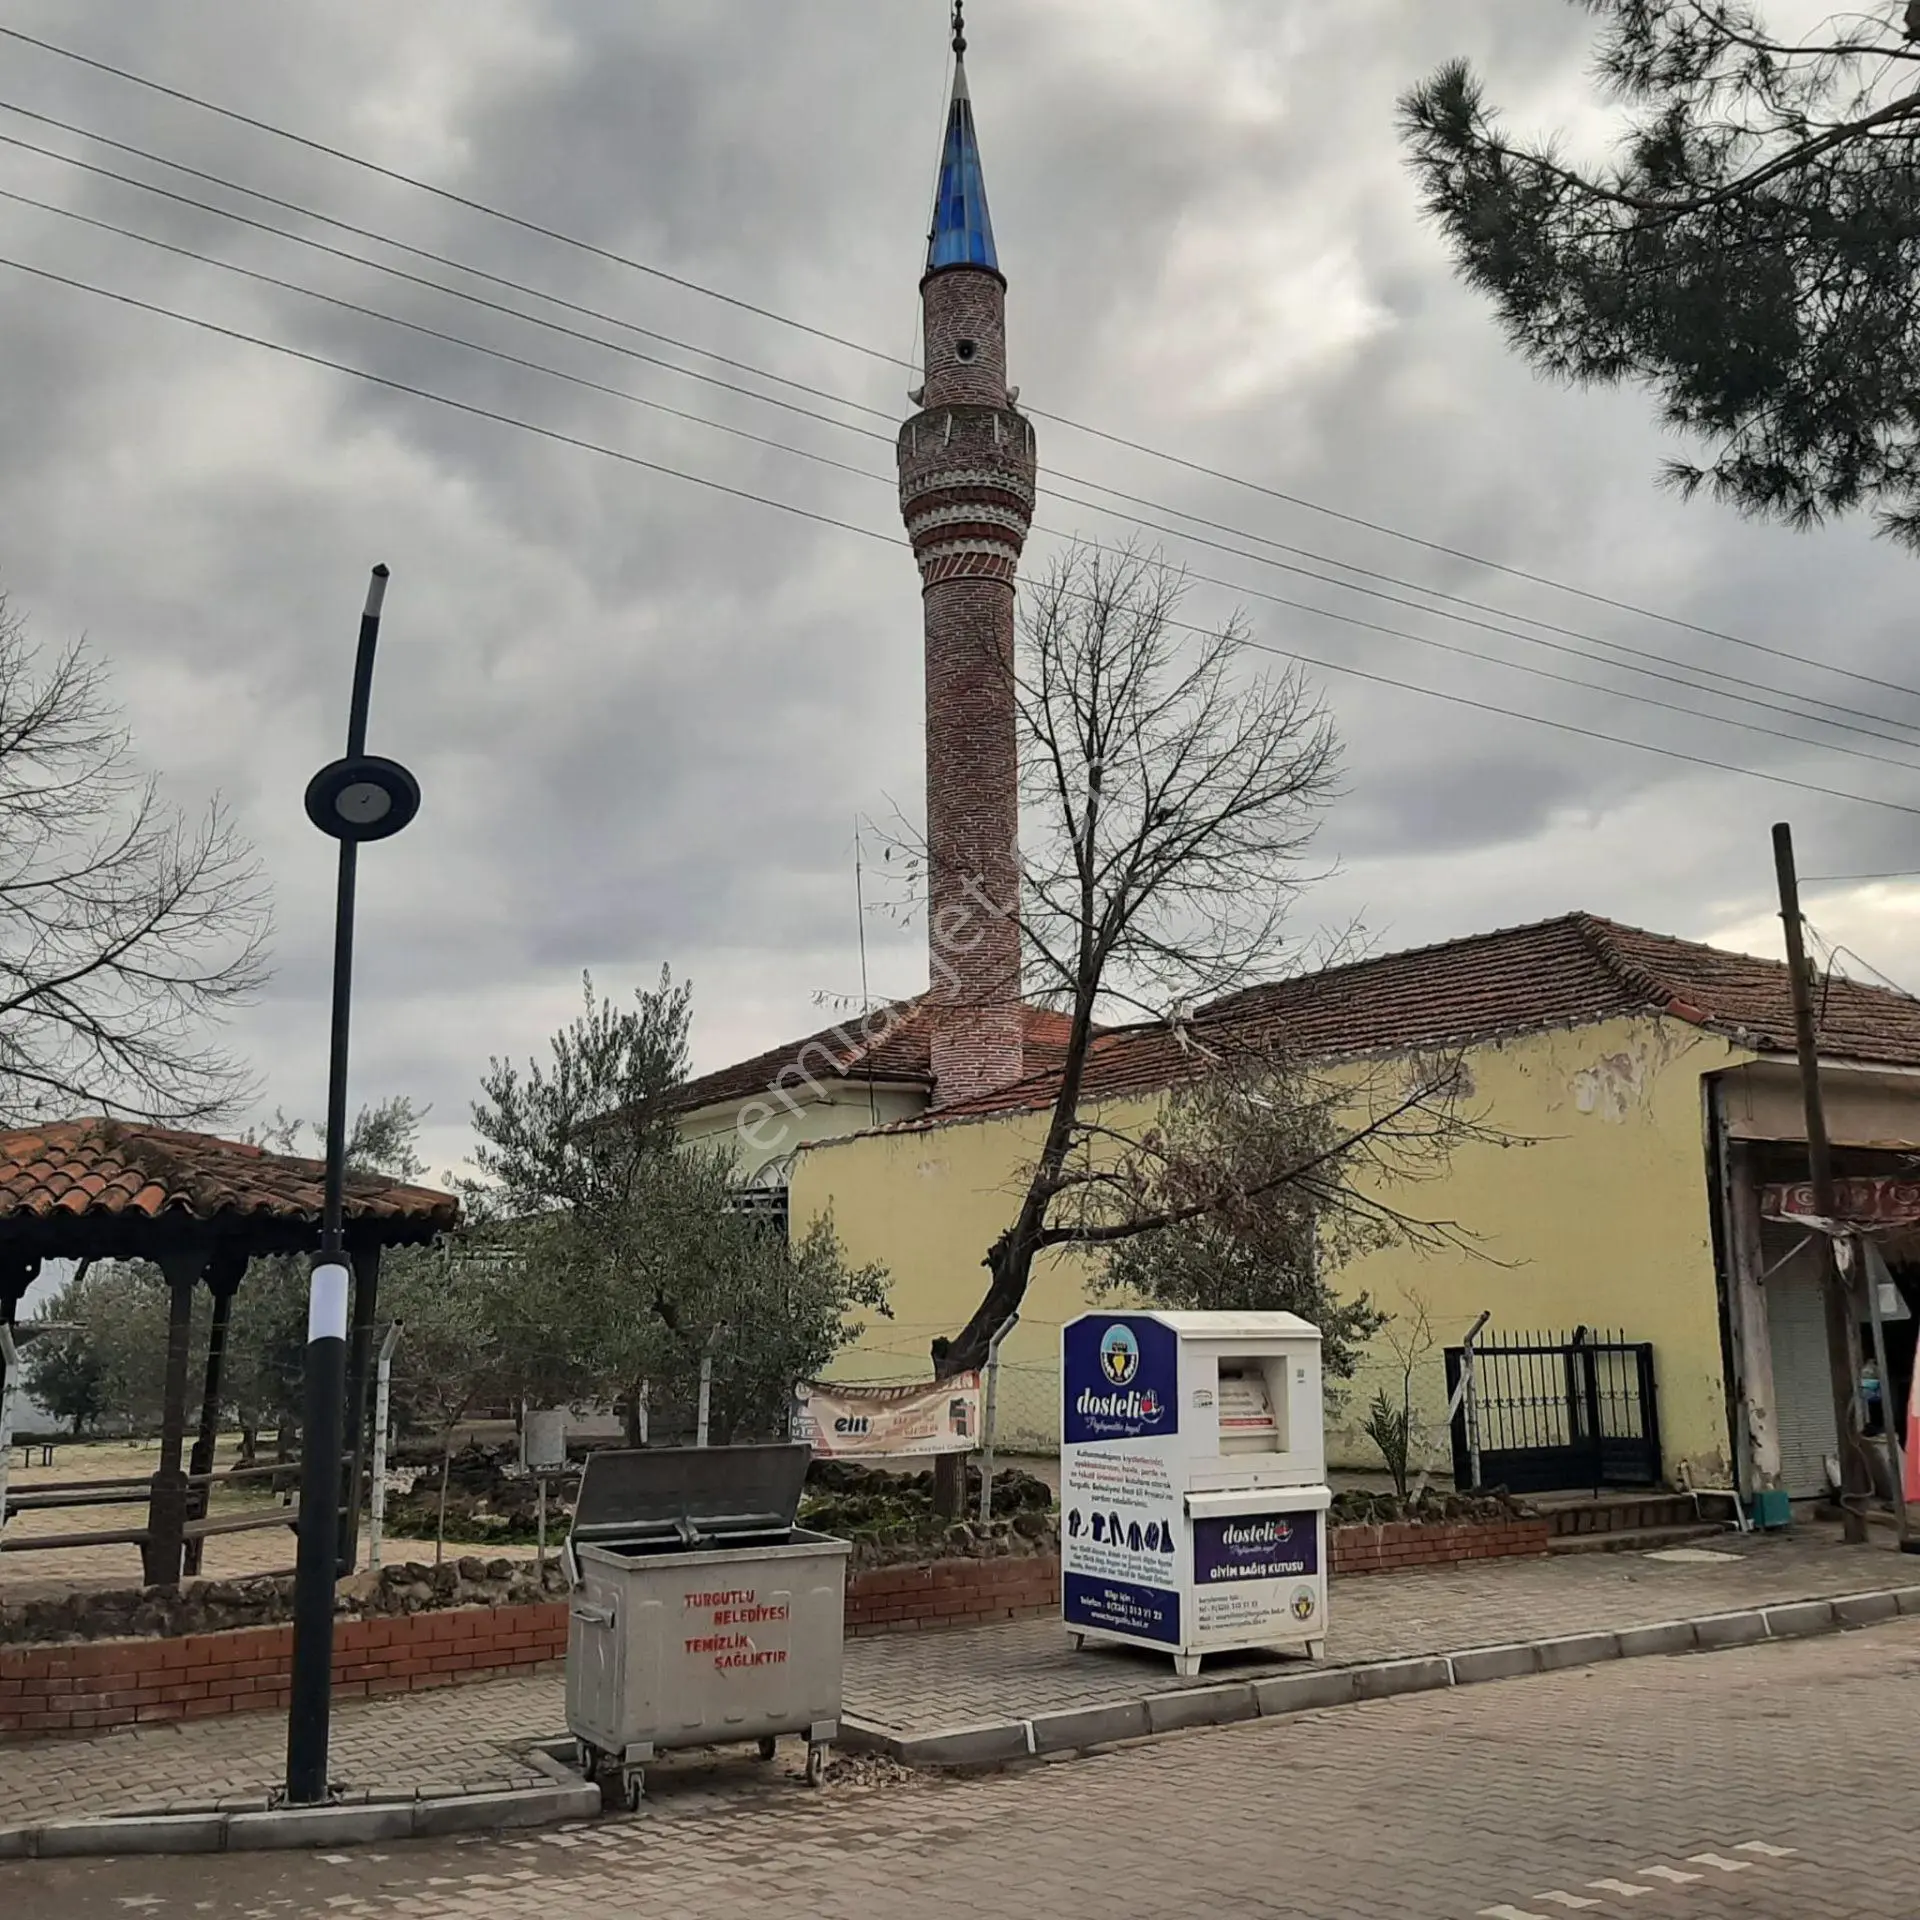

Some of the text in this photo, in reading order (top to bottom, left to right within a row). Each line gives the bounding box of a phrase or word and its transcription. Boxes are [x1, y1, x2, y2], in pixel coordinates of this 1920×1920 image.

[1076, 1387, 1140, 1418] dosteli
[834, 1414, 868, 1432] elit
[1222, 1521, 1275, 1544] dosteli
[1239, 1561, 1267, 1576] BAĞIŞ
[1268, 1561, 1304, 1573] KUTUSU
[684, 1590, 755, 1609] TURGUTLU
[714, 1602, 790, 1625] BELEDİYESİ
[685, 1633, 749, 1653] TEMİZLİK
[714, 1650, 787, 1669] SAĞLIKTIR
